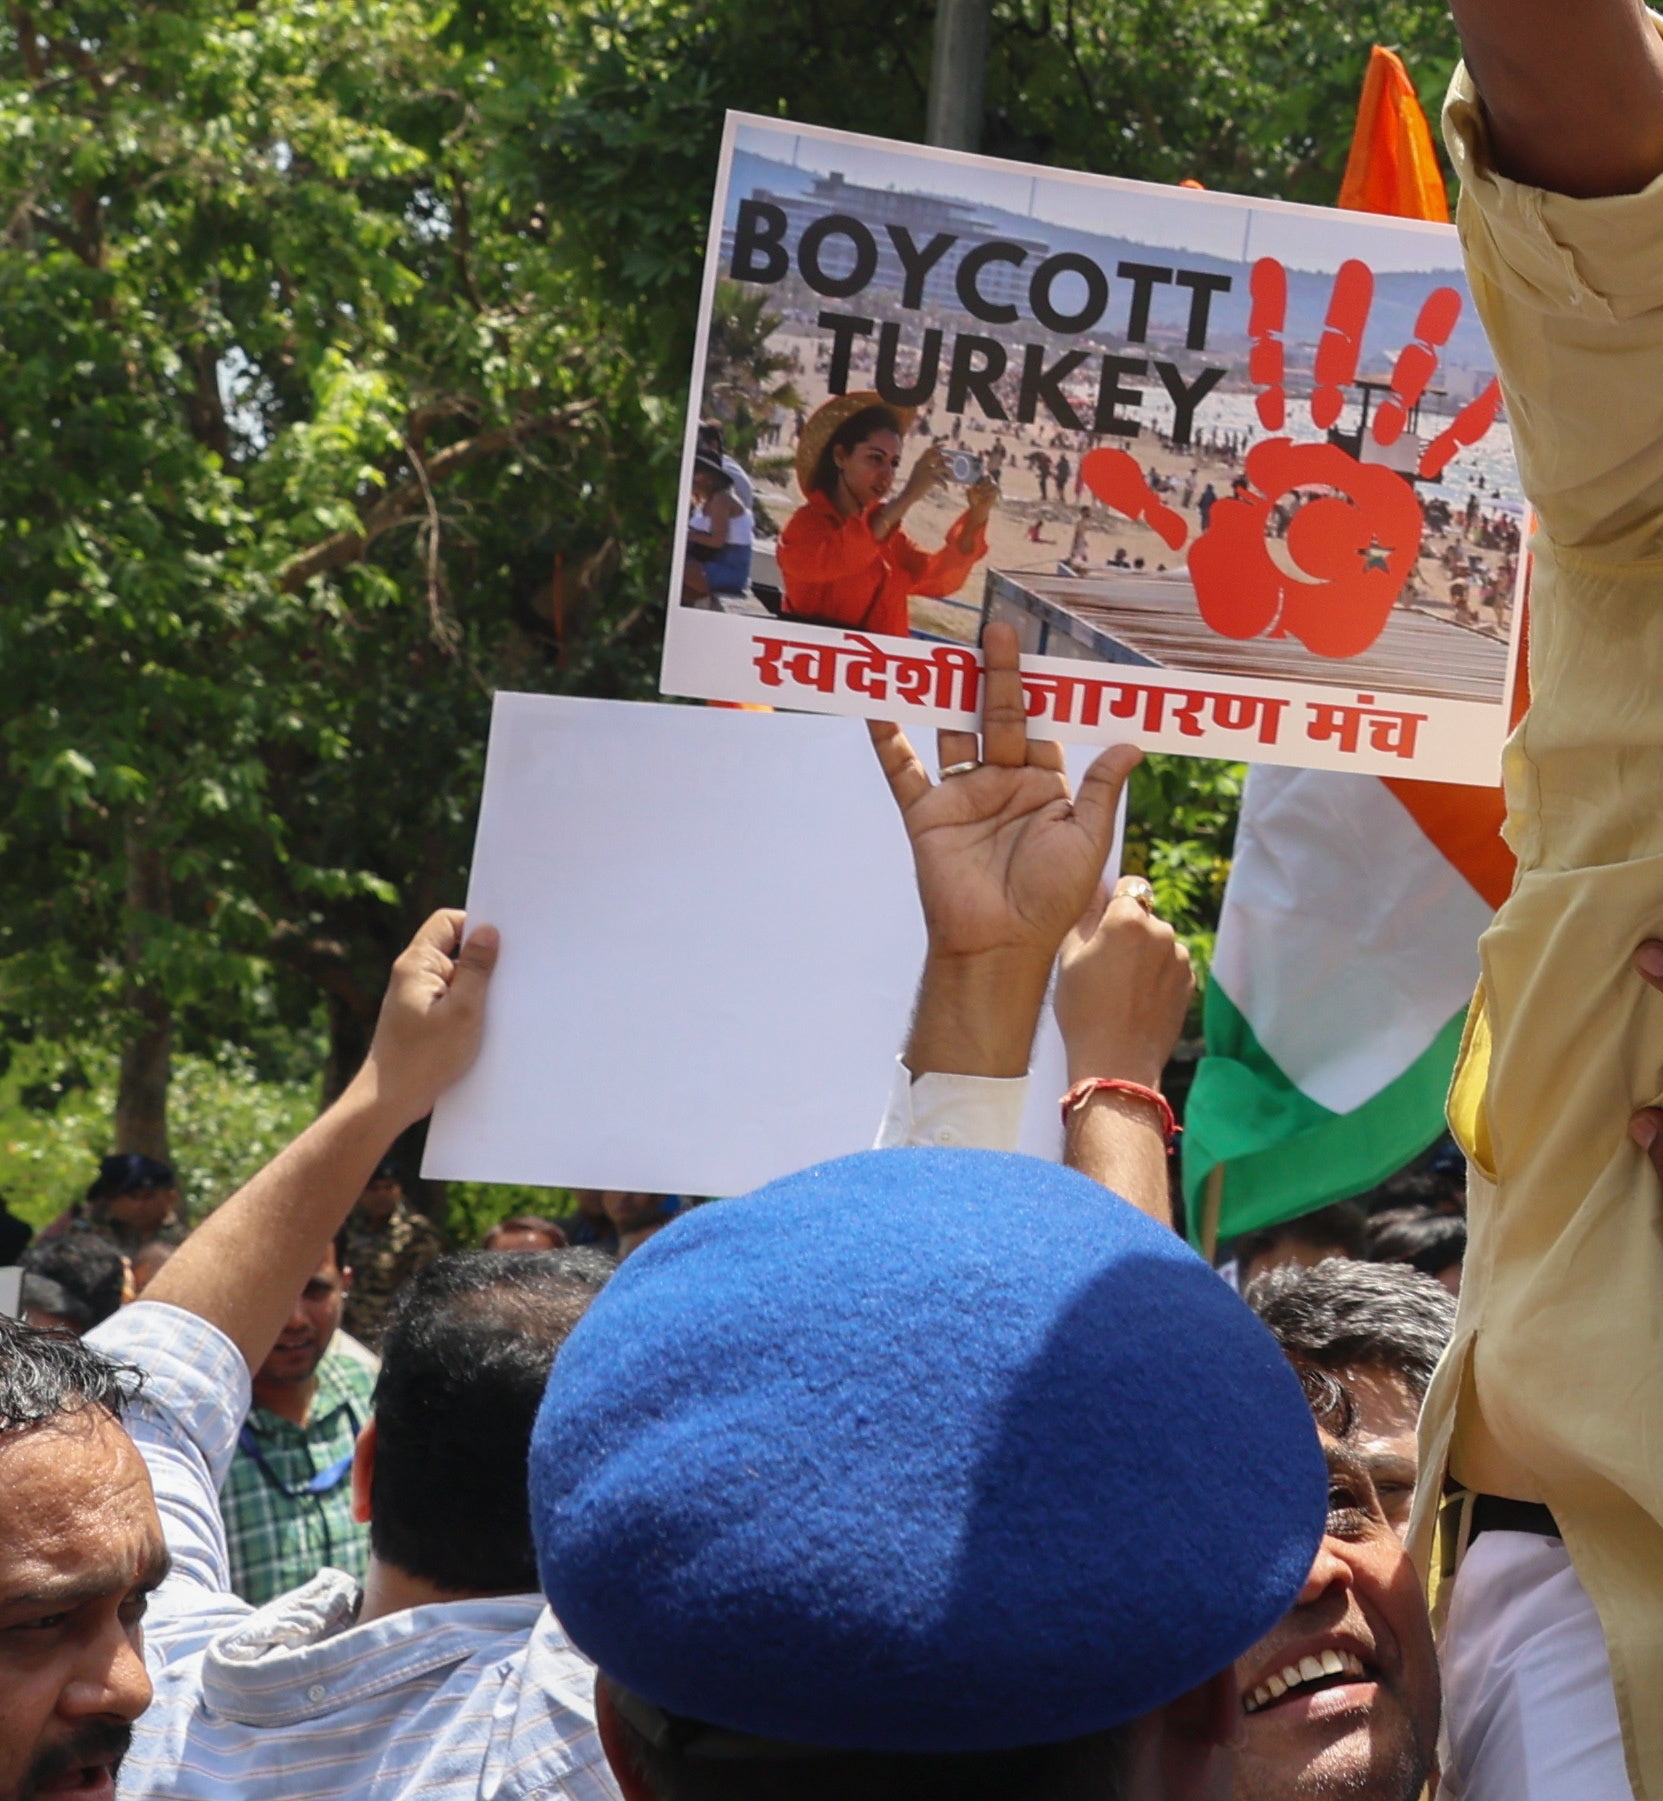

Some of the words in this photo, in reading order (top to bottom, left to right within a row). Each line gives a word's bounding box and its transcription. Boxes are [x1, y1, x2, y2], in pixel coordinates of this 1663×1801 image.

[730, 198, 1233, 352] BOYCOTT
[817, 310, 1229, 445] TURKEY
[751, 632, 984, 716] स्वदेशी
[1021, 670, 1290, 747] जागरण
[1305, 692, 1429, 759] मंच
